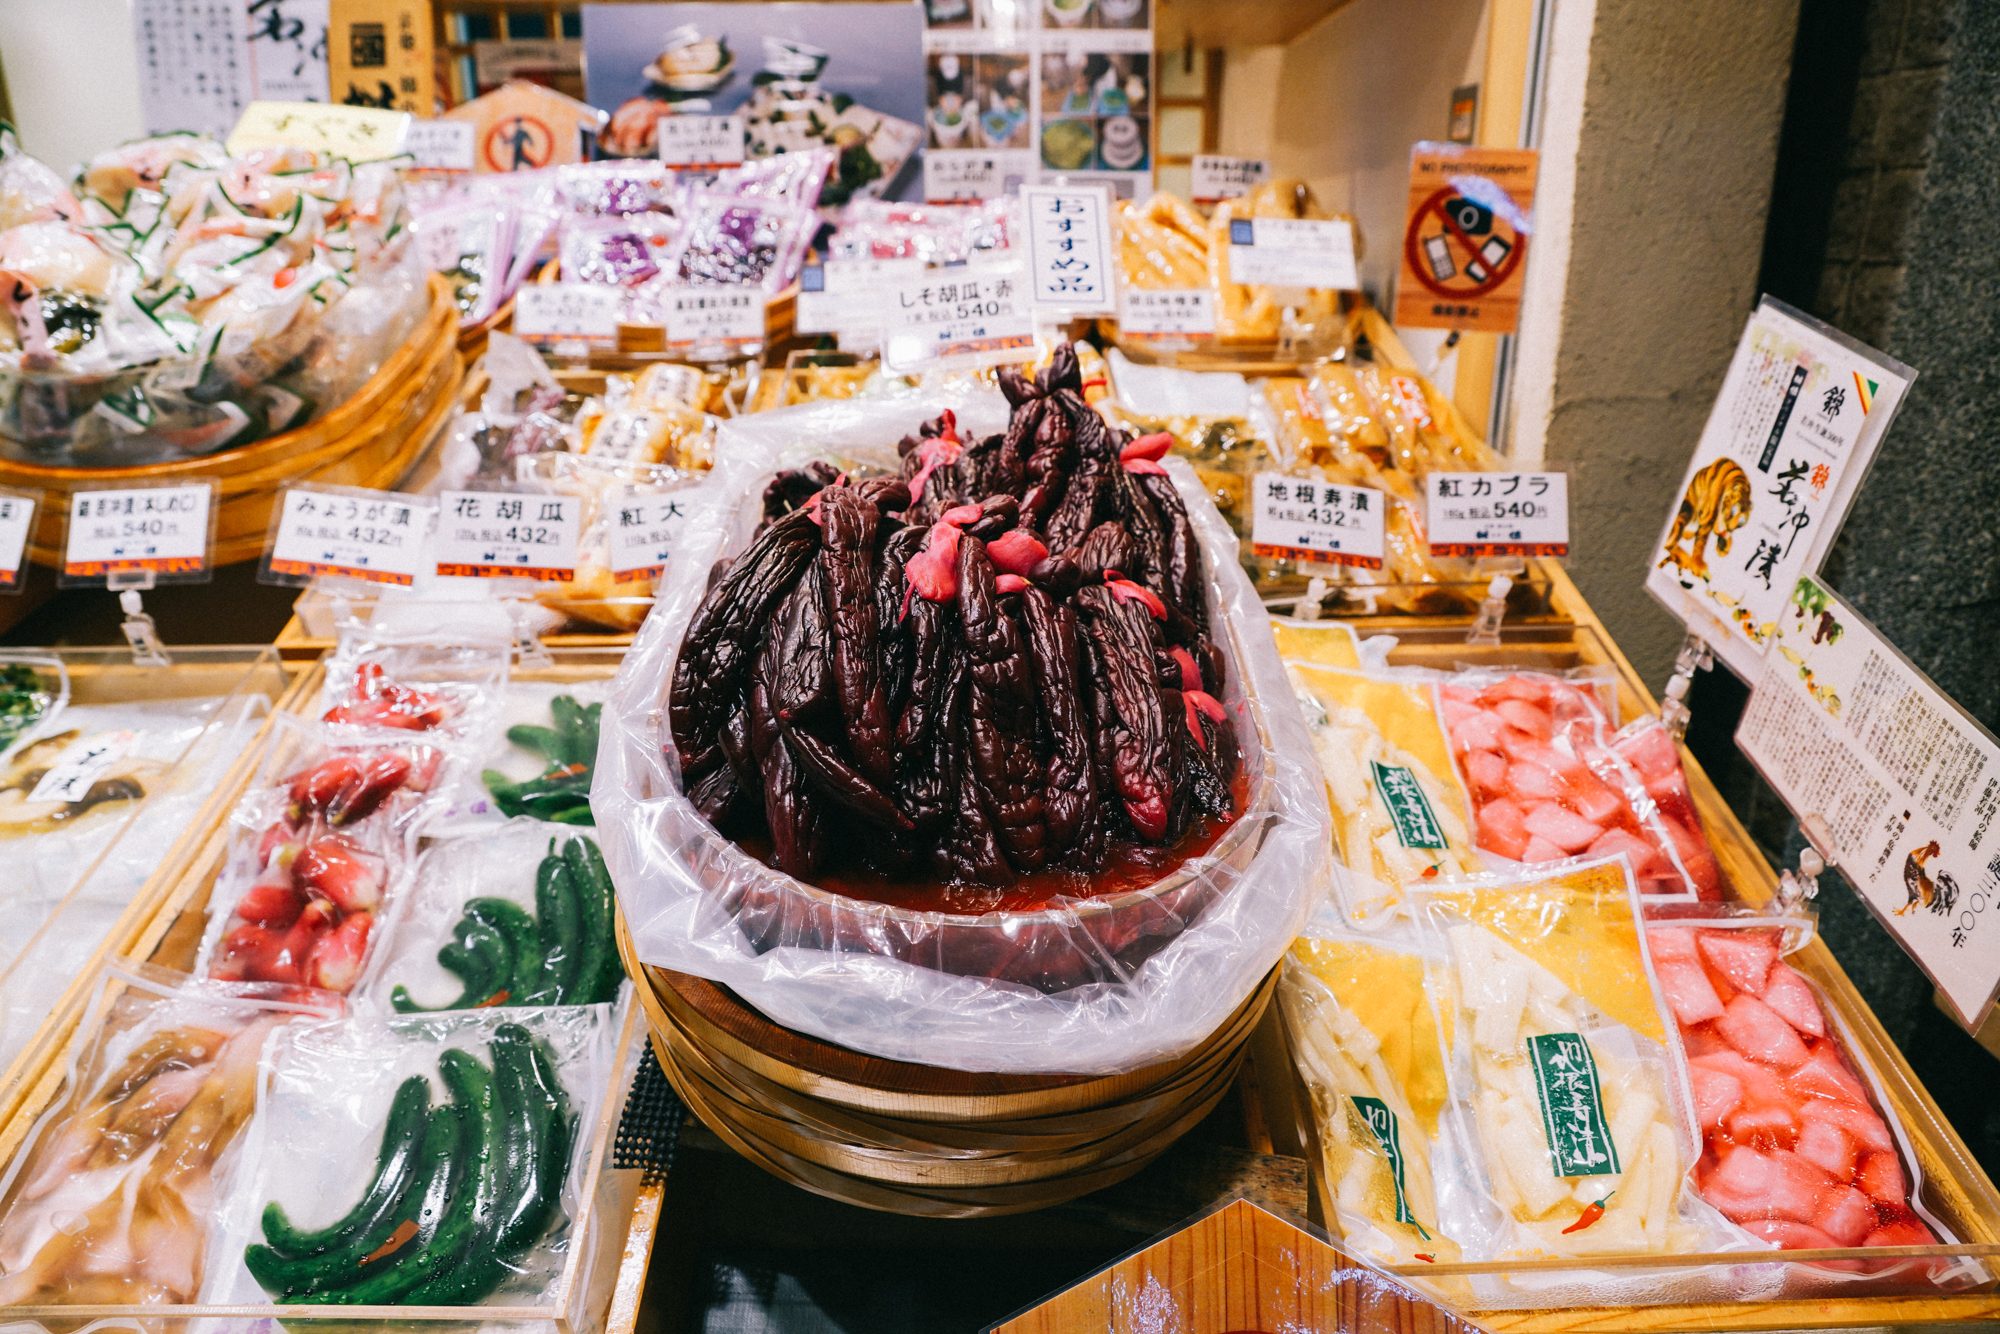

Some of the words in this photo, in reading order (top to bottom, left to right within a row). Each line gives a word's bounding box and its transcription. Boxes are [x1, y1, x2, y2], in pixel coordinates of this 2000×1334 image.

[1046, 196, 1094, 292] おすすめ品
[900, 279, 1014, 308] しそ胡瓜・赤
[1823, 386, 1845, 423] 錦
[1438, 475, 1550, 498] 紅カブラ
[1811, 462, 1831, 495] 錦
[297, 498, 410, 526] みょうが漬
[454, 498, 564, 521] 花胡瓜
[1267, 481, 1369, 512] 地根寿漬
[1973, 776, 1998, 817] 伊藤若冲
[1883, 812, 1897, 834] 若冲
[1968, 786, 2000, 850] 戸時代の絵師
[1868, 820, 1905, 883] 錦の危機救った
[1950, 848, 2000, 948] 誕三〇〇年
